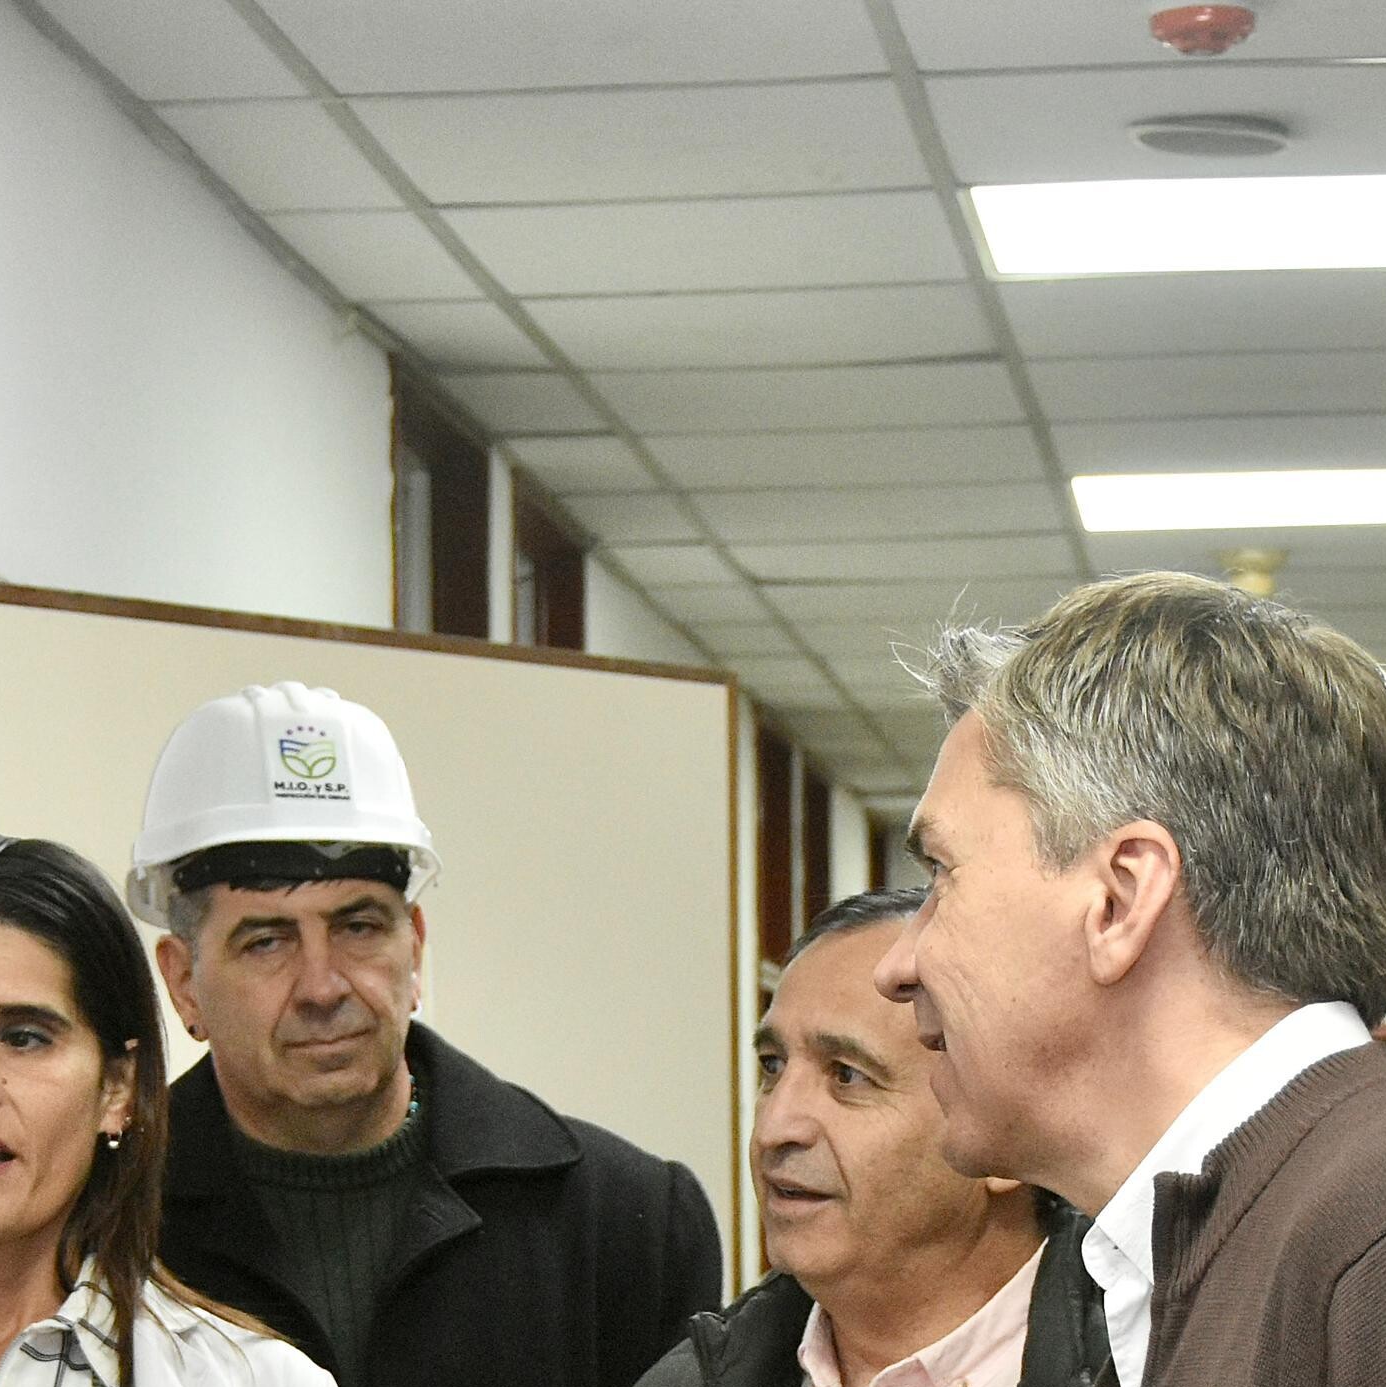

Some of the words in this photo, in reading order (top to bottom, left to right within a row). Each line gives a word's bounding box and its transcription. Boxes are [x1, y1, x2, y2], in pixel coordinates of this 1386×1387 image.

[274, 781, 311, 791] M.I.O.
[314, 784, 322, 793] y
[325, 783, 349, 793] S.P.
